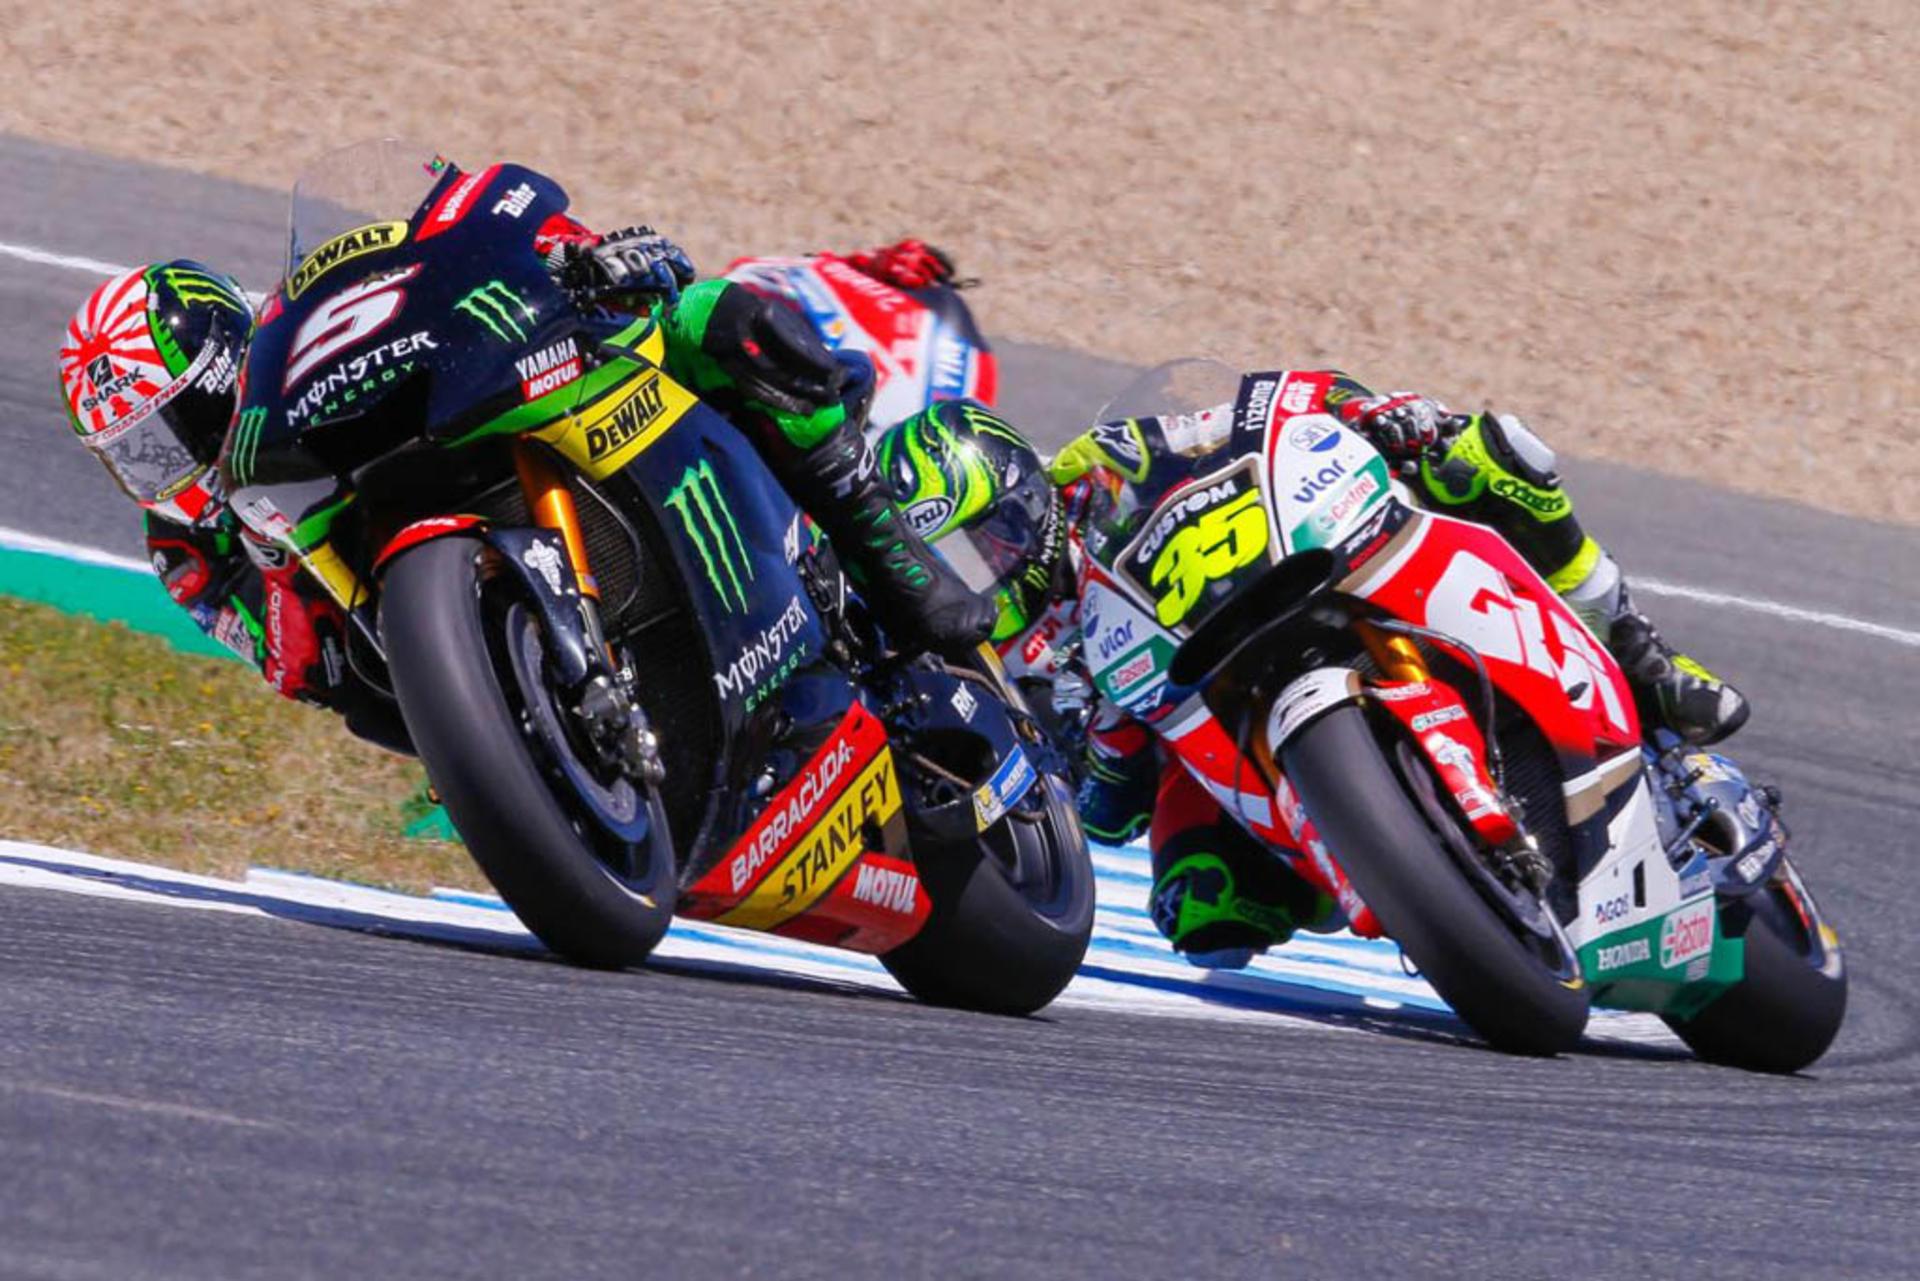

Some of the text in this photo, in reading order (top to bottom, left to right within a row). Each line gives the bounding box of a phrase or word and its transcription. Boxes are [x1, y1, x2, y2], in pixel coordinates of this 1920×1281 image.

[281, 262, 425, 396] 5
[514, 336, 579, 381] YAMAHA
[82, 366, 145, 413] SHARK
[309, 361, 415, 426] ENERGY
[529, 361, 580, 398] MOTUL
[1293, 459, 1347, 504] viar
[1137, 479, 1238, 564] CUSTOM
[1151, 486, 1269, 628] 35
[1099, 619, 1134, 660] viar
[745, 642, 807, 713] ENERGY
[731, 738, 851, 893] BARRACUDA
[777, 762, 889, 908] STANLEY
[853, 862, 918, 914] MOTUL
